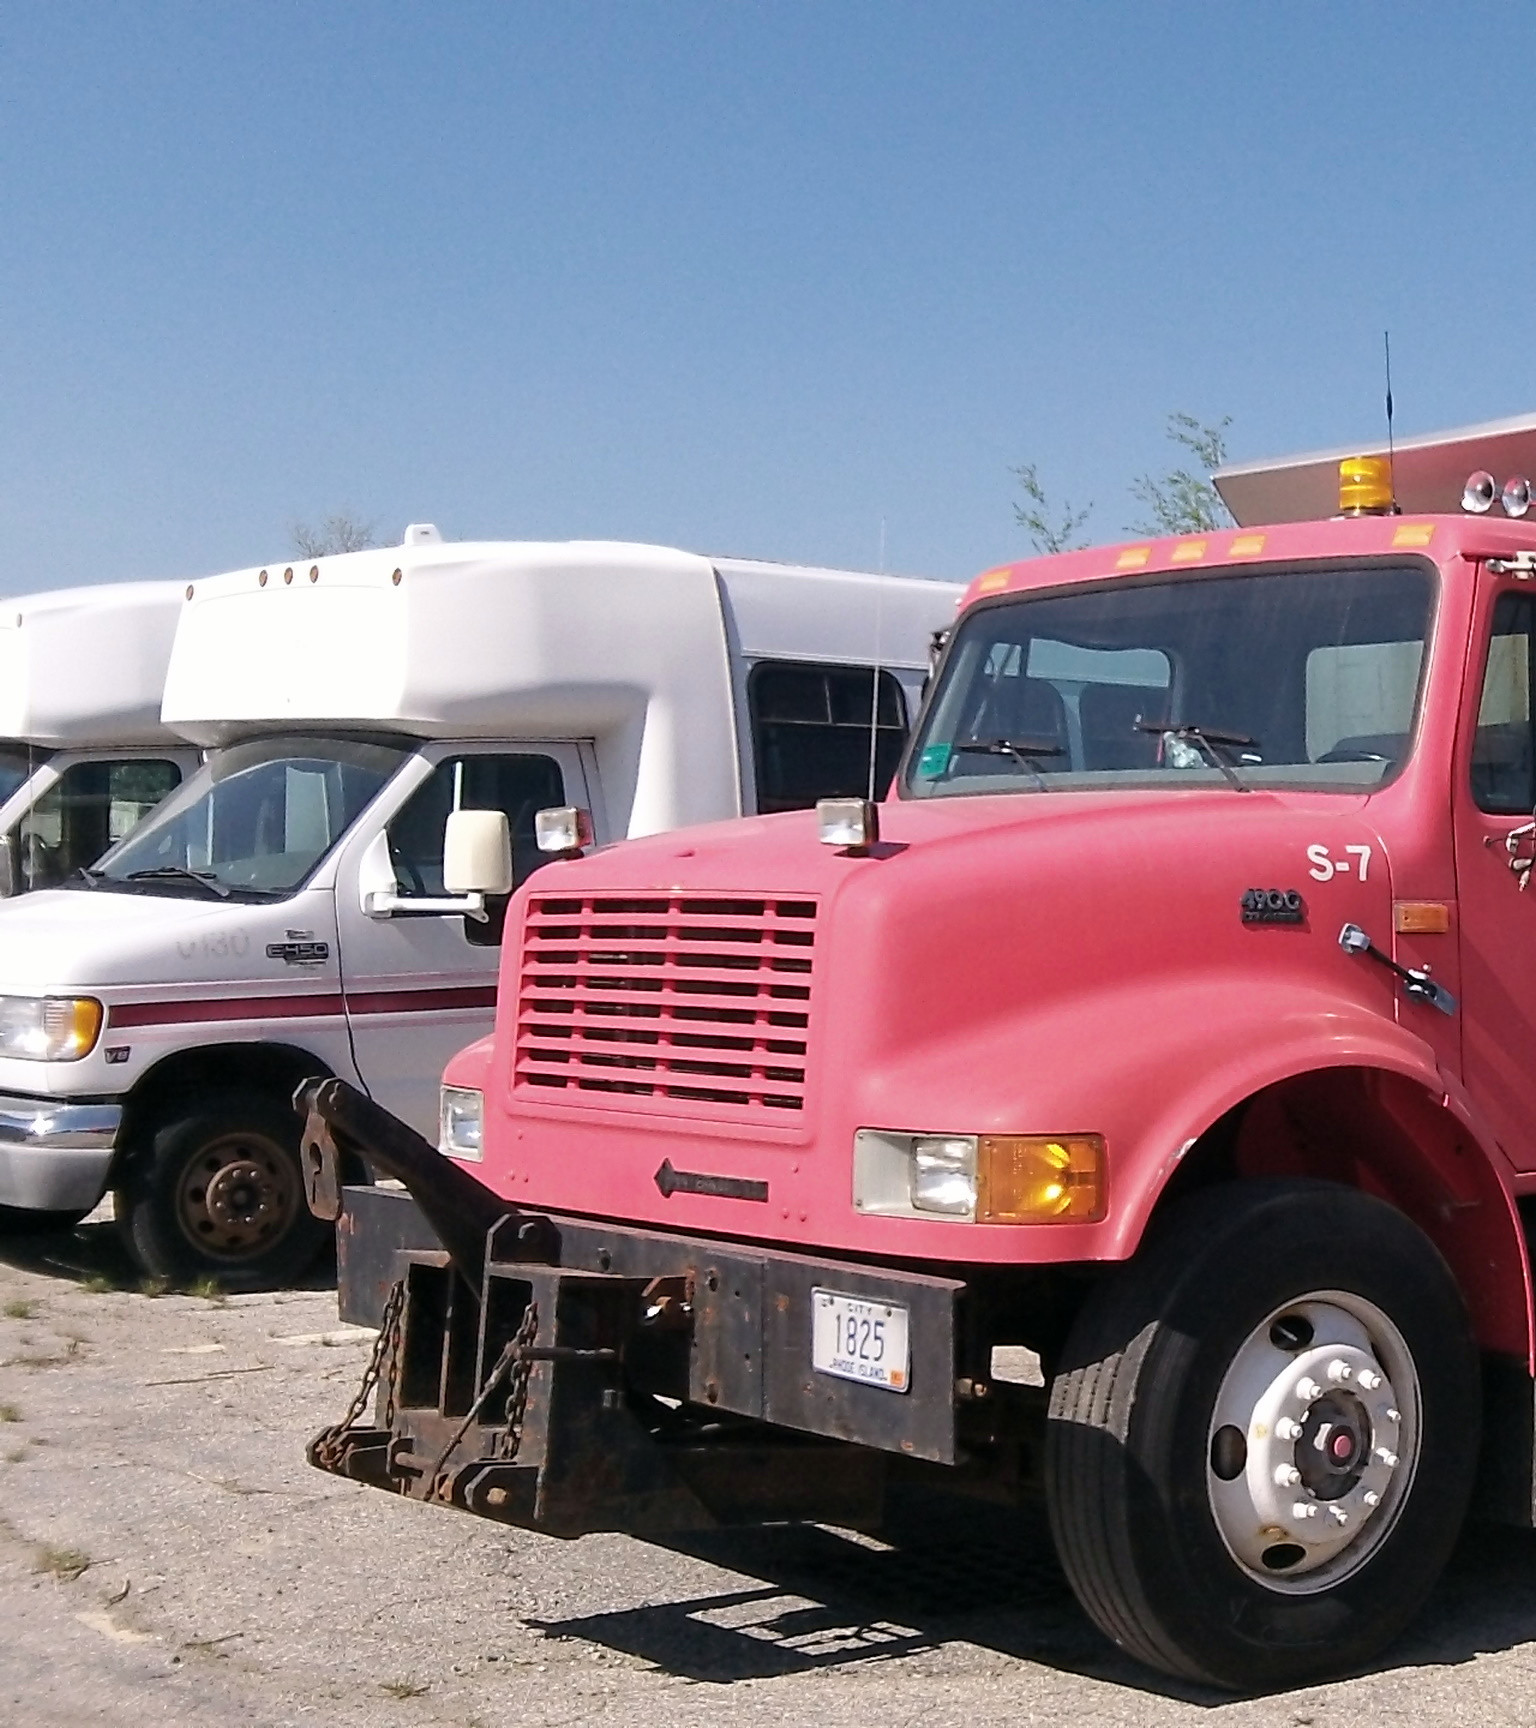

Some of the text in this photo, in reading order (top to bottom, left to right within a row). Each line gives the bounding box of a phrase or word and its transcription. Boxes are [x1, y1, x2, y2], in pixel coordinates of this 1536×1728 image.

[1306, 843, 1372, 882] S-7
[267, 943, 328, 957] E450
[835, 1314, 885, 1362] 1825
